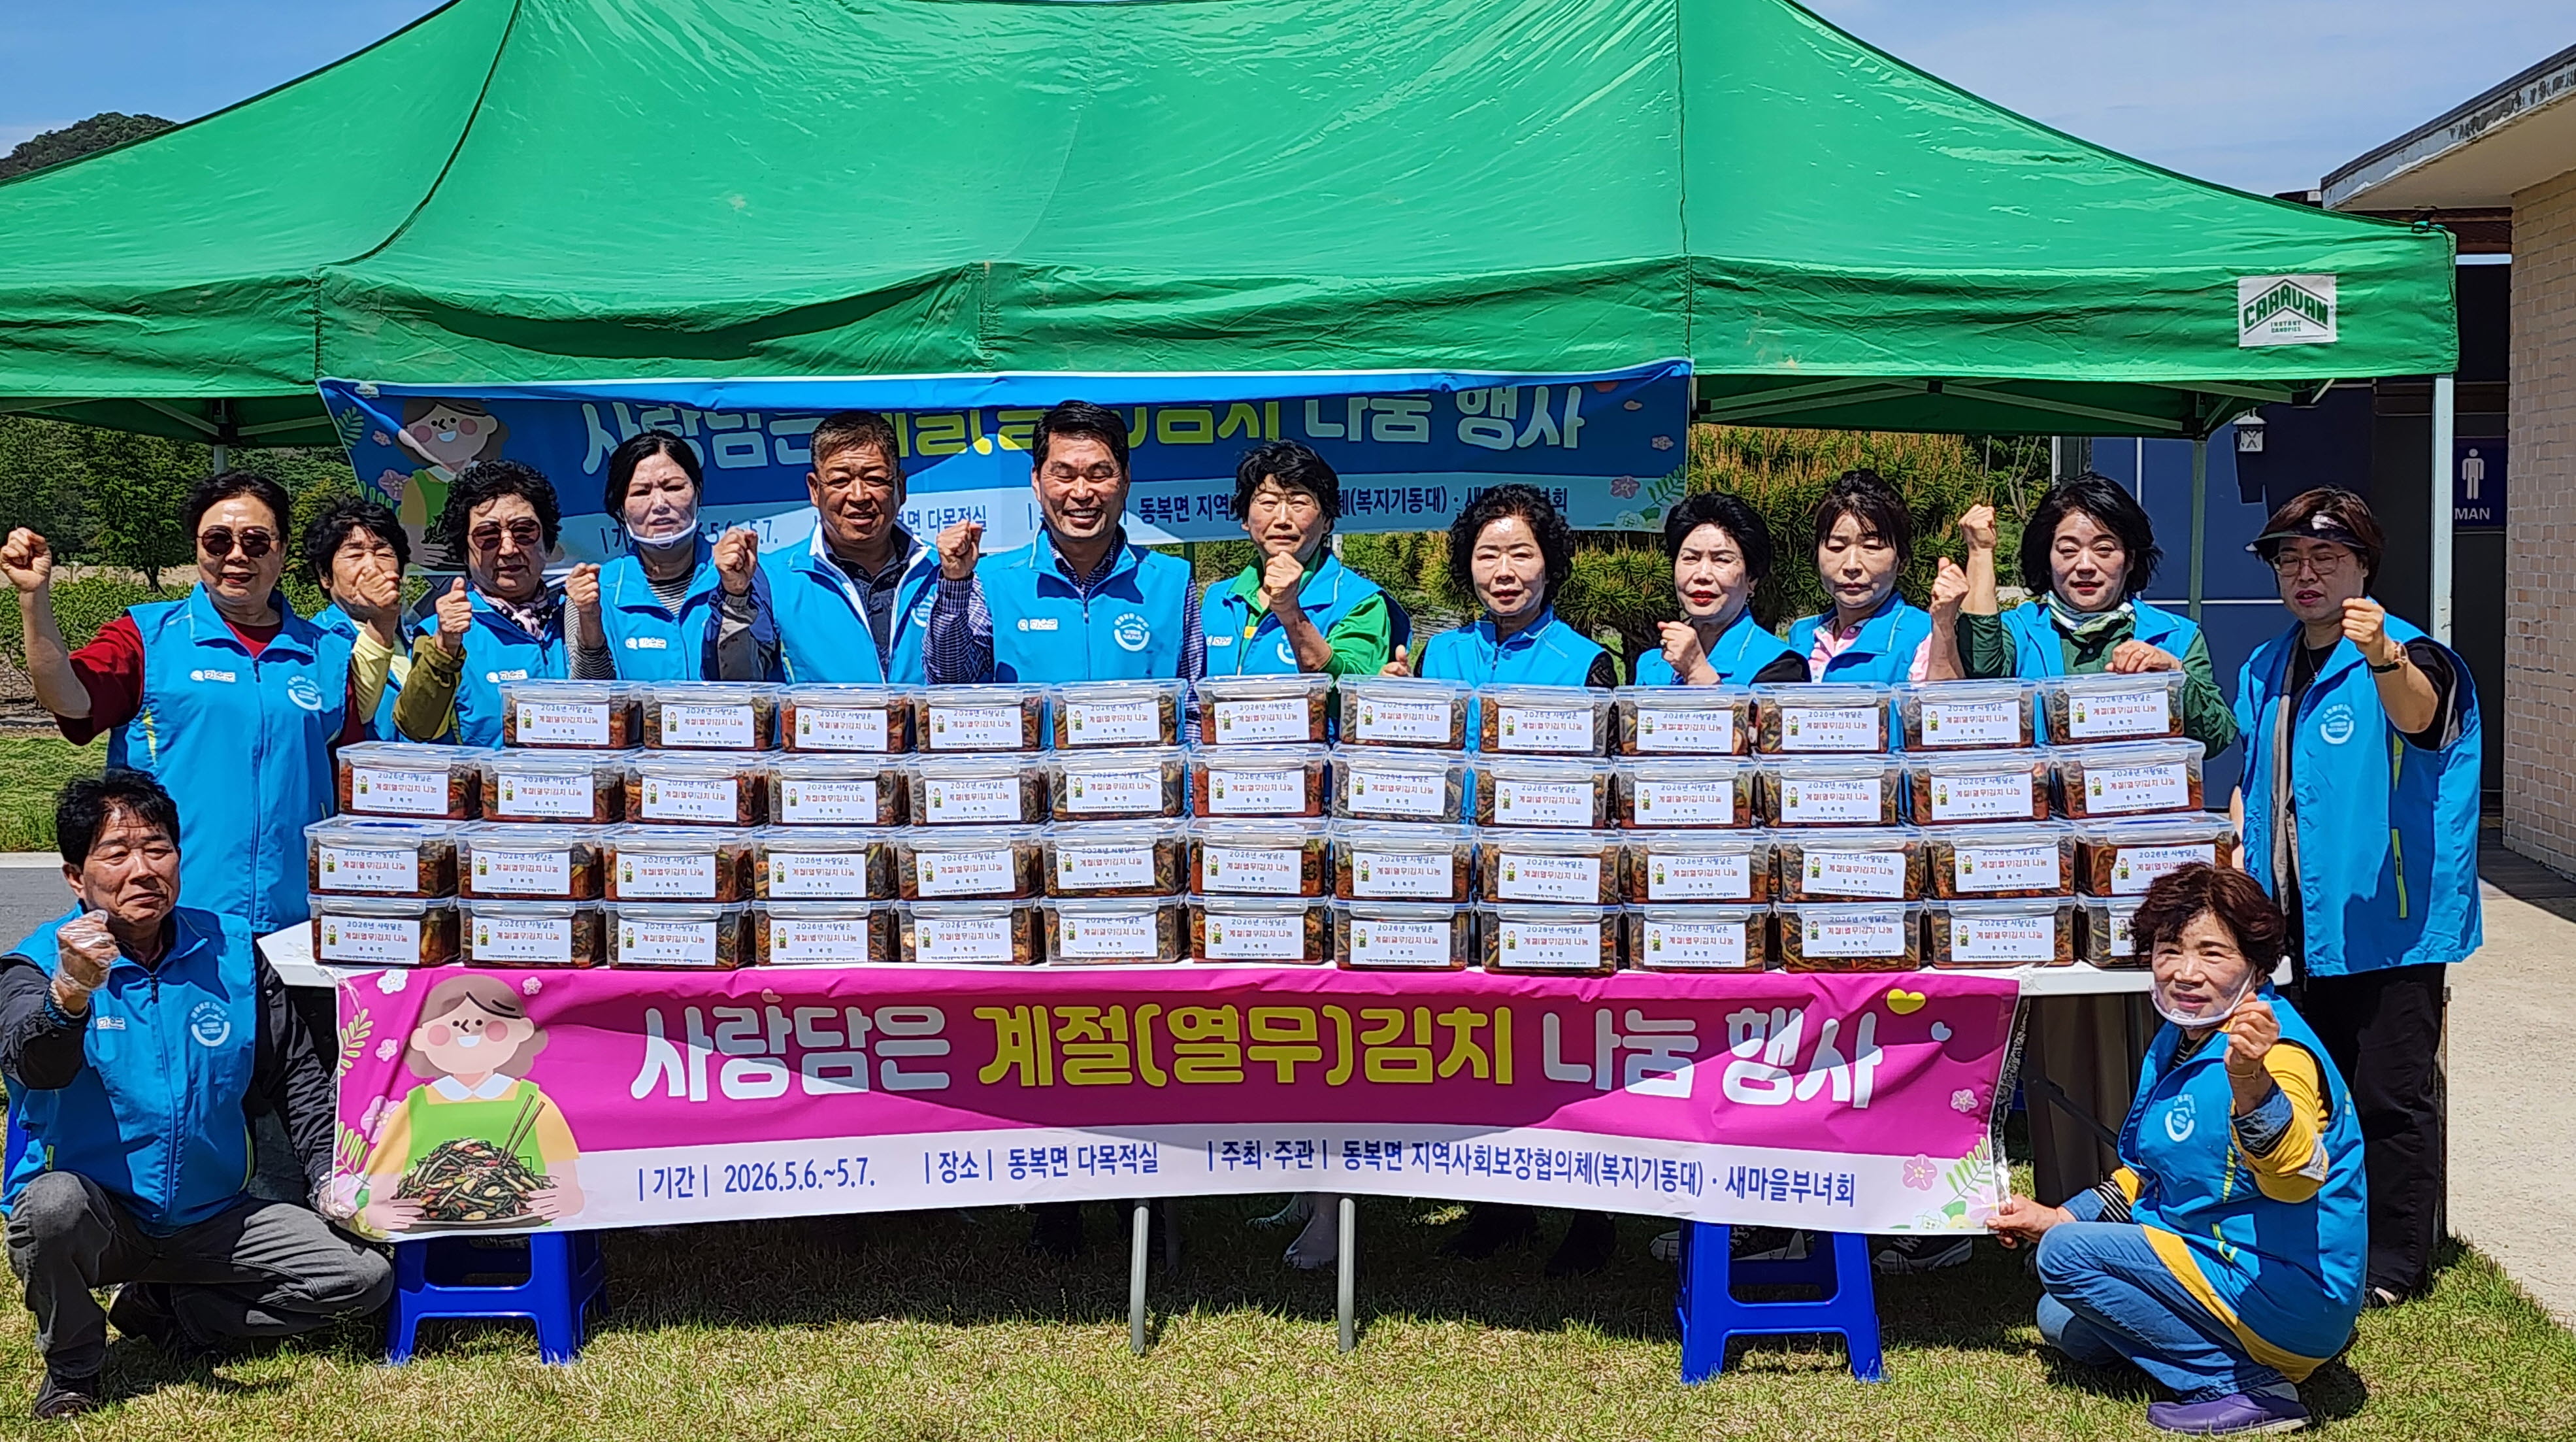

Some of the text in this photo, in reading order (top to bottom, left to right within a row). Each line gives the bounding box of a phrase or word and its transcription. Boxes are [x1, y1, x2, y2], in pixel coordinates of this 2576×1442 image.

[2243, 284, 2328, 328] CARAVAN
[1456, 386, 1585, 450] 행사
[1140, 495, 1189, 524] 동복면
[2454, 507, 2490, 520] MAN
[631, 1003, 1883, 1109] 사랑담은 계절(열무)김치 나눔 행사
[724, 1157, 876, 1194] 2026.5.6.~5.7.
[1008, 1146, 1068, 1181] 동복면
[1078, 1141, 1158, 1177] 다목적실
[1342, 1141, 1403, 1171] 동복면
[1412, 1142, 1704, 1197] 지역사회보장협의체(복지기동대)
[1725, 1165, 1855, 1208] 새마을부녀회
